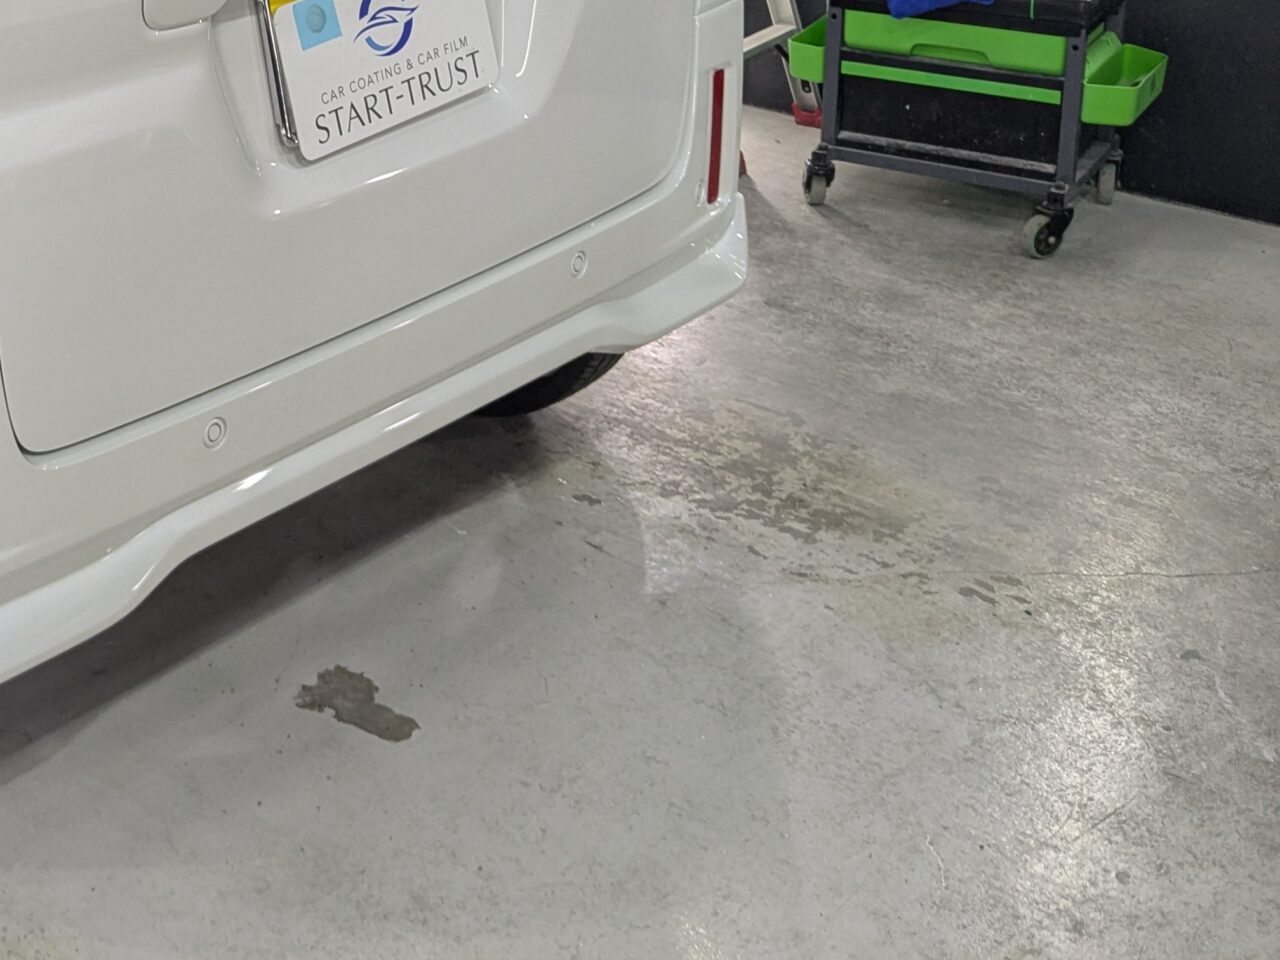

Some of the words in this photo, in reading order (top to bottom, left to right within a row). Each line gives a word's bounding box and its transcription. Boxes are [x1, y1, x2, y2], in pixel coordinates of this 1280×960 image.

[315, 50, 480, 144] START-TRUST
[321, 85, 345, 105] CAR
[349, 62, 402, 93] COATING
[406, 58, 415, 71] &
[417, 47, 441, 66] CAR
[443, 36, 469, 55] FILM
